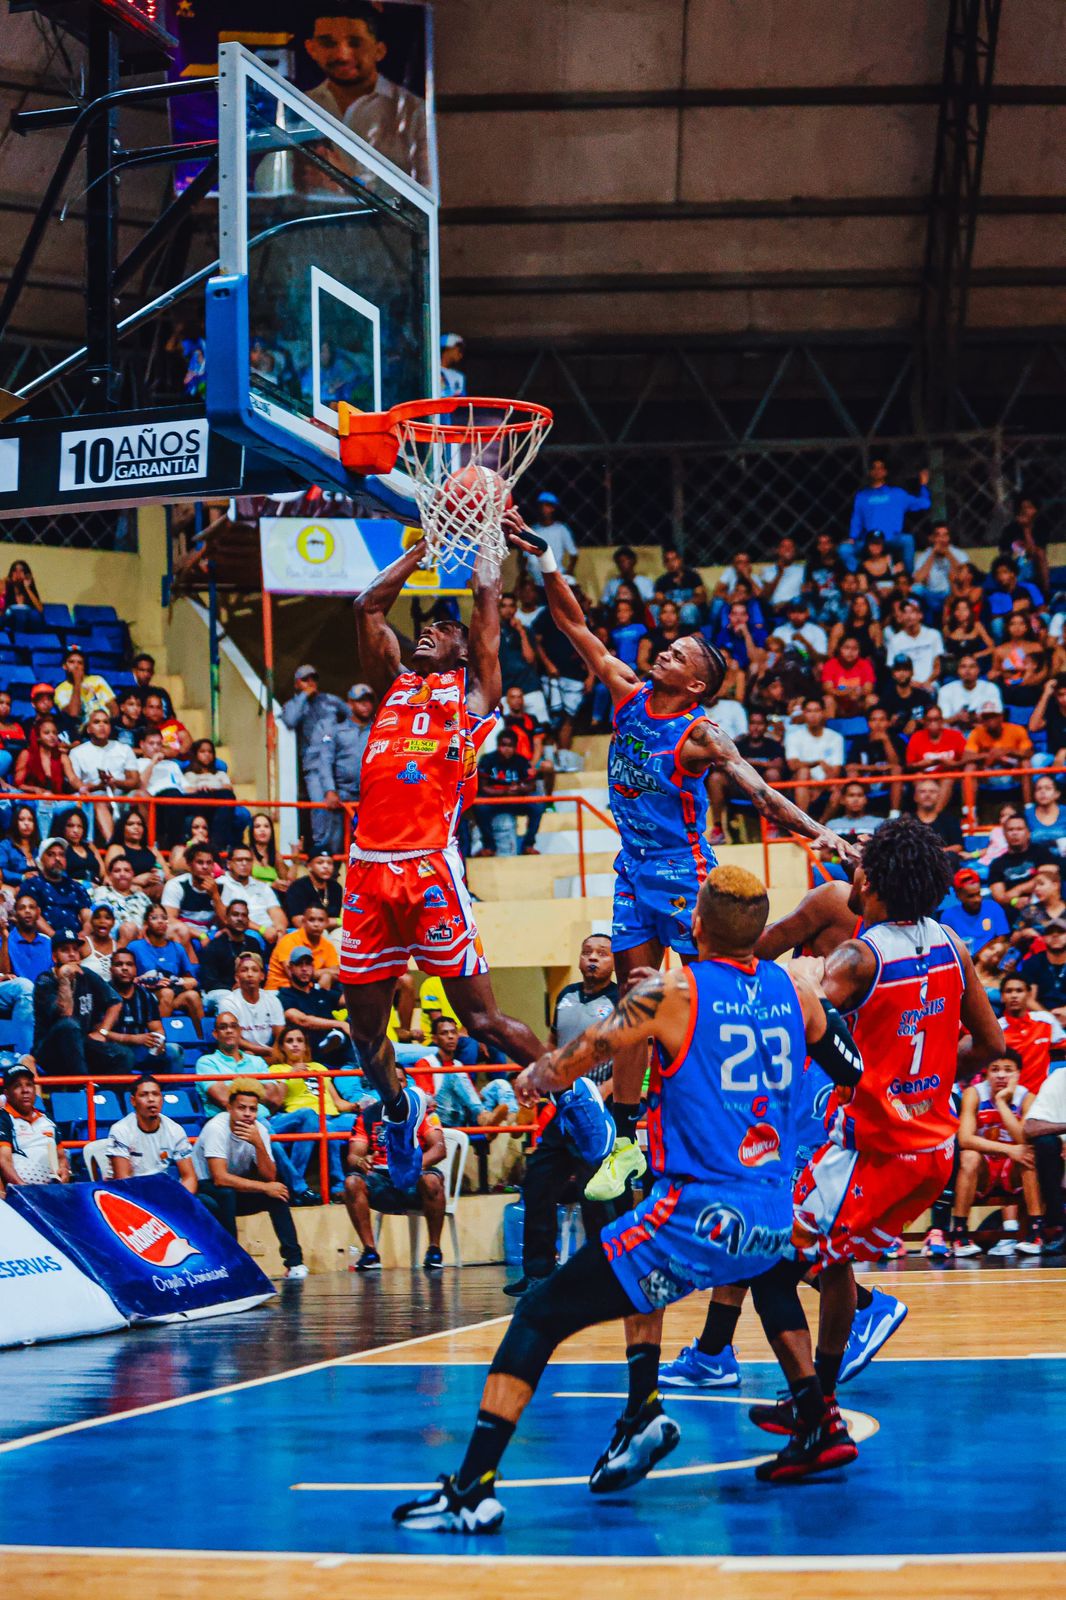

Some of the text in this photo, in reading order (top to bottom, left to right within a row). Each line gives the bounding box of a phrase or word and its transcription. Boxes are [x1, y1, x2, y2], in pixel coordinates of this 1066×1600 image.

[68, 428, 200, 485] 10 AÑOS
[115, 457, 198, 480] GARANTÍA
[411, 711, 431, 736] 0
[719, 1023, 793, 1092] 23
[909, 1030, 926, 1076] 1
